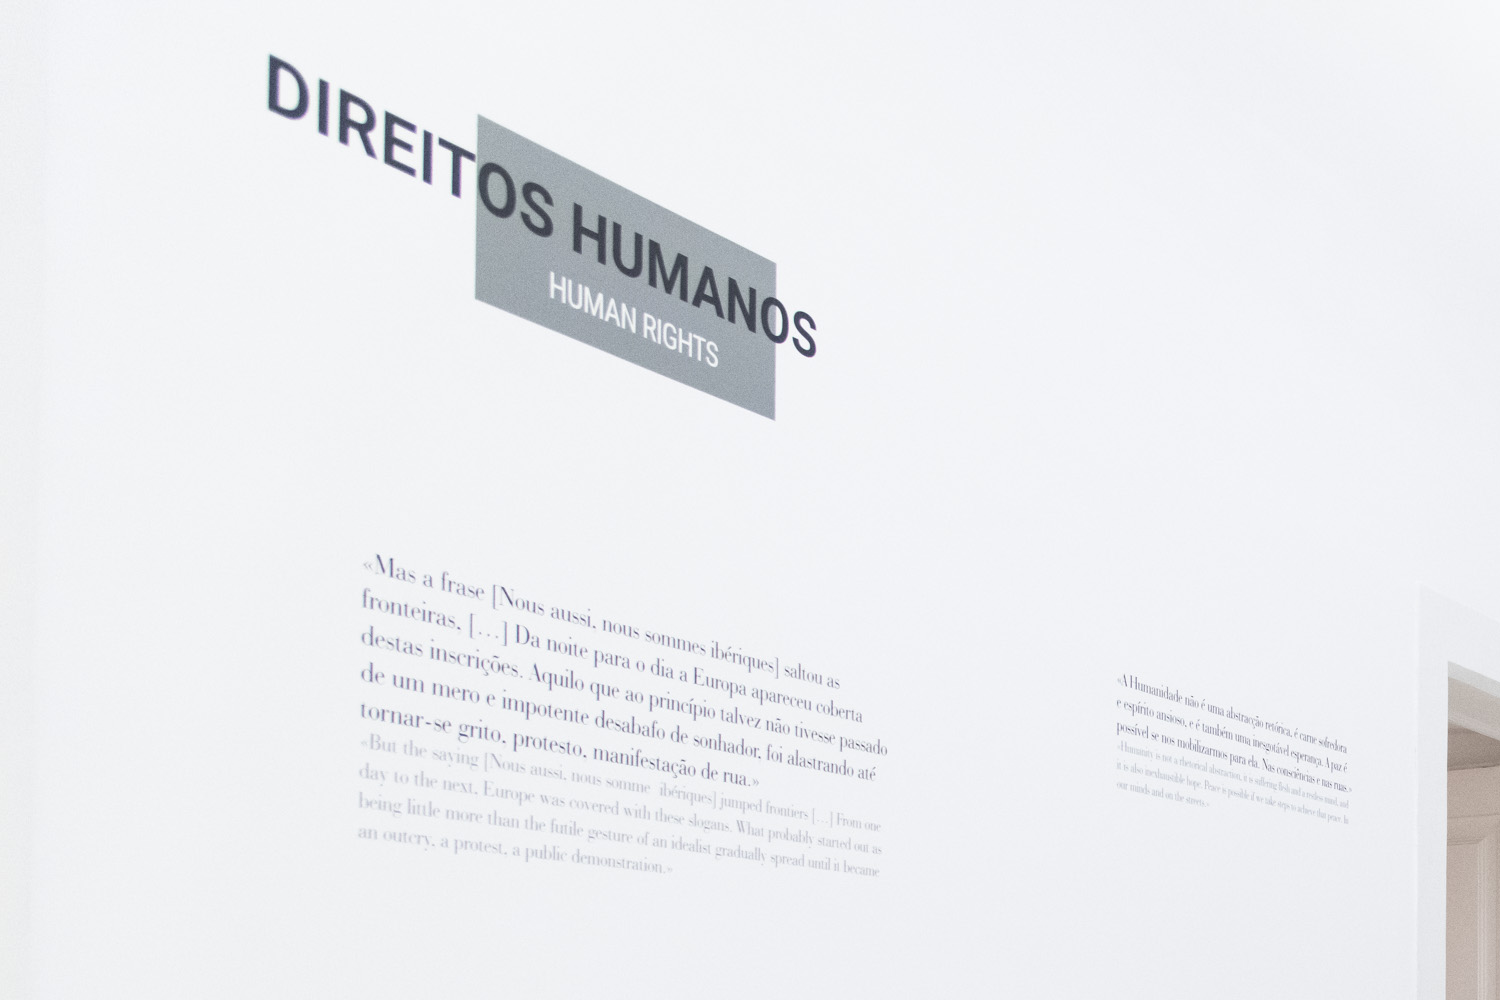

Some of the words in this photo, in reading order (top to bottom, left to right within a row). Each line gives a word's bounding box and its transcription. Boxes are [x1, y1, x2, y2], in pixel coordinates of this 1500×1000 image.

[267, 53, 555, 238] DIREITOS
[572, 202, 818, 358] HUMANOS
[548, 270, 637, 335] HUMAN
[642, 311, 720, 368] RIGHTS
[363, 553, 416, 582] «Mas
[422, 574, 433, 588] a
[441, 571, 485, 599] frase
[492, 584, 544, 615] [Nous
[603, 619, 640, 638] nous
[645, 632, 706, 654] sommes
[711, 641, 779, 679] ibériques]
[784, 663, 822, 685] saltou
[827, 677, 840, 689] as
[360, 662, 385, 683] de
[393, 674, 424, 693] um
[432, 682, 480, 702] mero
[486, 694, 496, 706] e
[502, 689, 589, 724] impotente
[594, 710, 665, 739] desabafo
[670, 725, 688, 743] de
[767, 744, 782, 763] foi
[787, 749, 854, 776] alastrando
[858, 767, 876, 780] até
[361, 625, 423, 655] destas
[430, 639, 523, 678] inscrições.
[529, 663, 584, 691] Aquilo
[590, 682, 620, 701] que
[625, 690, 644, 703] ao
[649, 691, 716, 722] princípio
[720, 707, 761, 729] talvez
[766, 717, 790, 734] não
[795, 722, 835, 743] tivesse
[840, 736, 888, 755] passado
[516, 623, 540, 649] Da
[547, 636, 588, 658] noite
[594, 650, 630, 669] para
[636, 661, 645, 671] o
[650, 657, 674, 679] dia
[679, 671, 687, 682] a
[694, 666, 746, 699] Europa
[751, 688, 812, 711] apareceu
[816, 700, 862, 723] coberta
[1130, 675, 1183, 703] Humanidade
[1185, 695, 1199, 708] não
[1201, 698, 1205, 710] é
[1207, 704, 1224, 717] uma
[1226, 707, 1264, 729] abstracção
[1294, 728, 1298, 739] é
[1299, 732, 1317, 744] carne
[1318, 737, 1347, 754] sofredora
[361, 704, 452, 733] tornar-se
[593, 747, 696, 779] manifestação
[701, 761, 718, 780] de
[723, 771, 759, 786] rua.»
[1116, 699, 1122, 708] e
[1123, 701, 1154, 717] espírito
[1195, 719, 1200, 730] é
[1202, 723, 1233, 741] também
[1235, 734, 1251, 746] uma
[1253, 734, 1289, 757] inesgotável
[1290, 750, 1323, 768] esperança.
[1325, 757, 1330, 768] A
[1331, 762, 1342, 773] paz
[1343, 763, 1347, 772] é
[1116, 722, 1149, 739] possível
[1151, 732, 1159, 741] se
[1161, 734, 1175, 745] nos
[1177, 737, 1228, 760] mobilizarmos
[1229, 754, 1246, 766] para
[1248, 754, 1259, 769] ela.
[1262, 757, 1275, 773] Nas
[1276, 767, 1315, 784] consciências
[1322, 779, 1332, 788] nas
[357, 827, 378, 840] an
[440, 837, 449, 849] a
[512, 847, 520, 857] a
[525, 844, 567, 863] public
